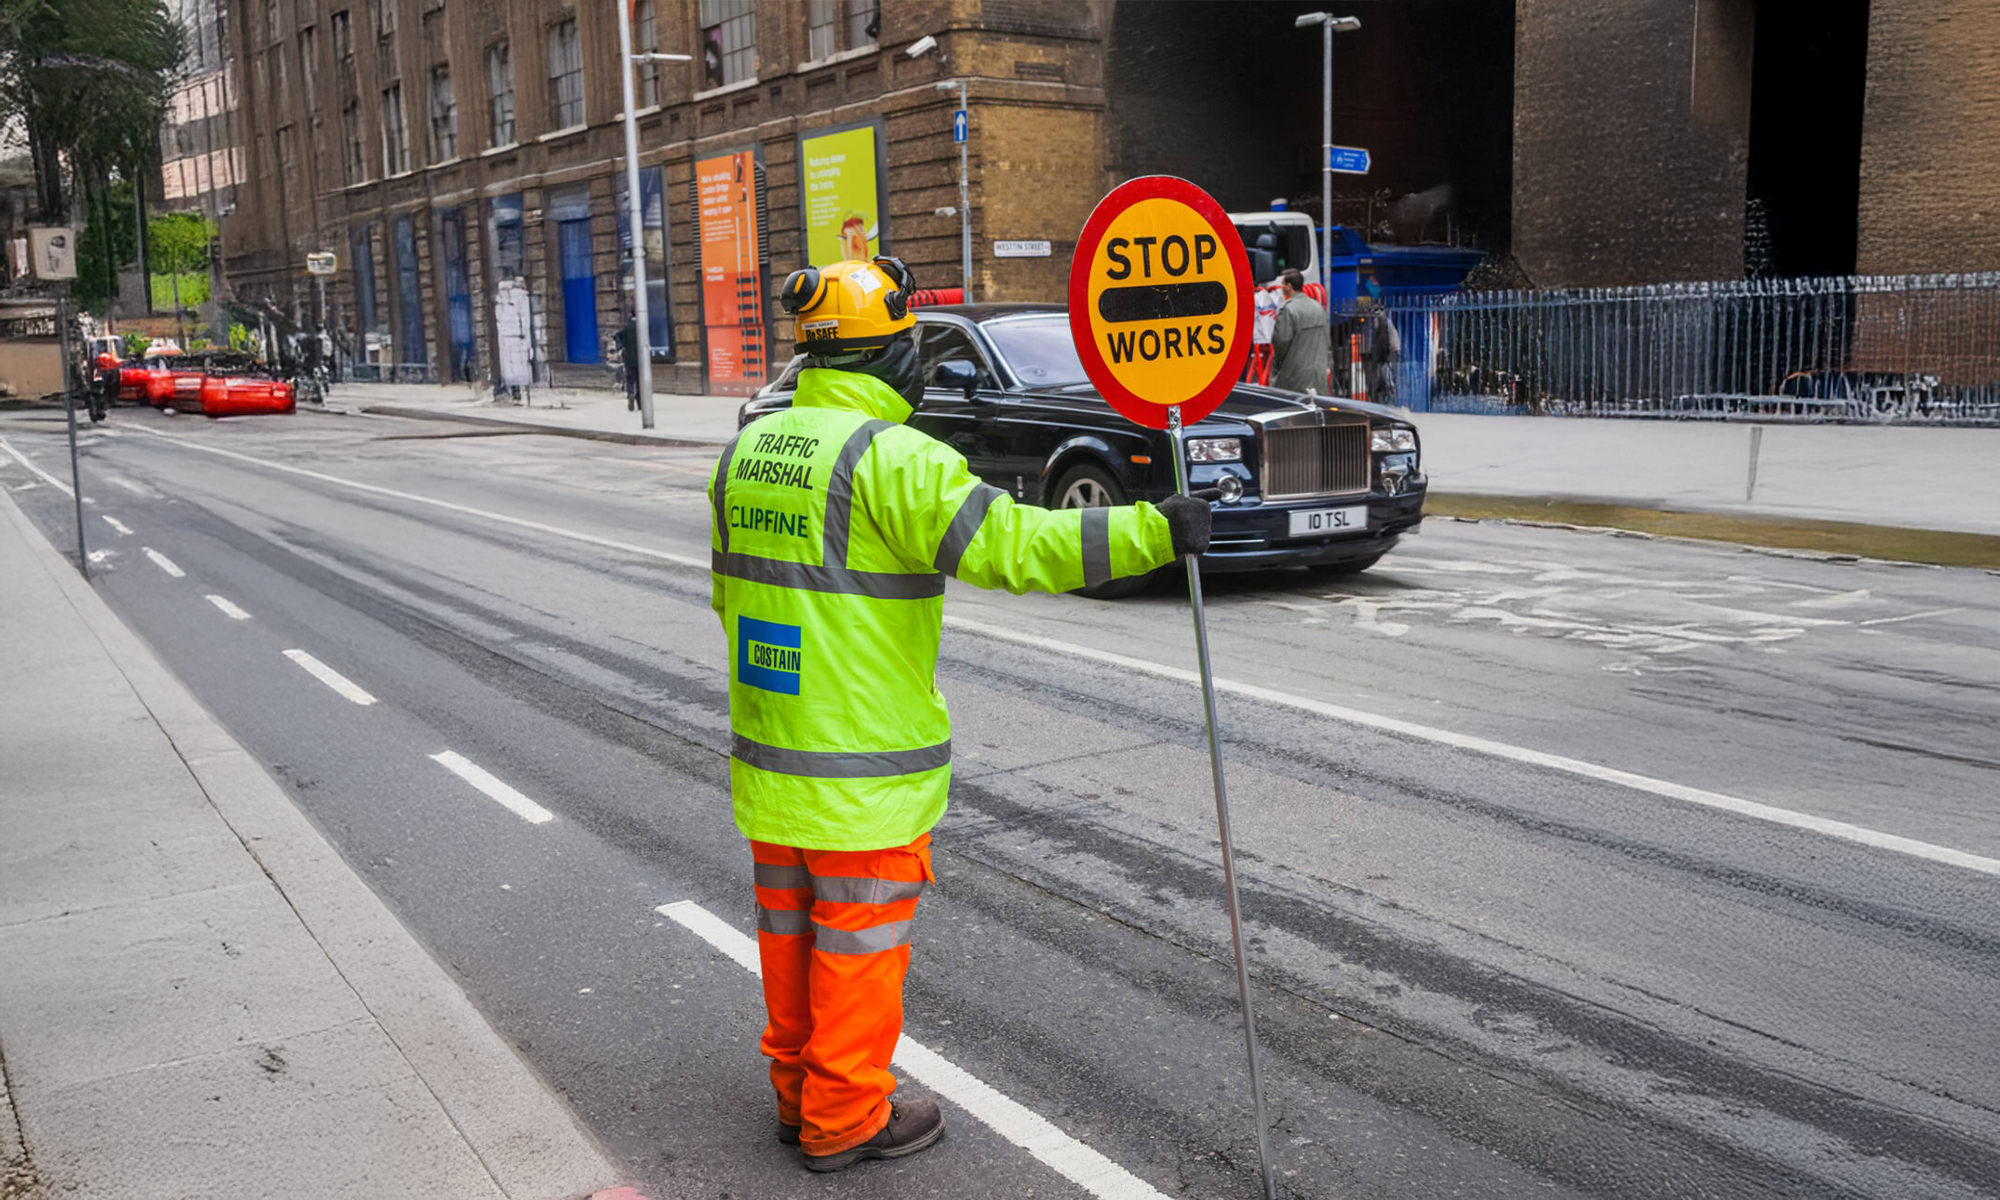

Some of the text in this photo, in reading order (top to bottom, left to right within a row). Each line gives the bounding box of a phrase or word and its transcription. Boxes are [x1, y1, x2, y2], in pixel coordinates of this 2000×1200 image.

[1106, 233, 1217, 280] STOP
[1107, 323, 1226, 364] WORKS
[753, 433, 820, 459] TRAFFIC
[735, 458, 814, 491] MARSHAL
[731, 505, 809, 539] CLIPFINE
[1308, 510, 1350, 530] 10 TSL
[754, 643, 802, 672] COSTAIN
